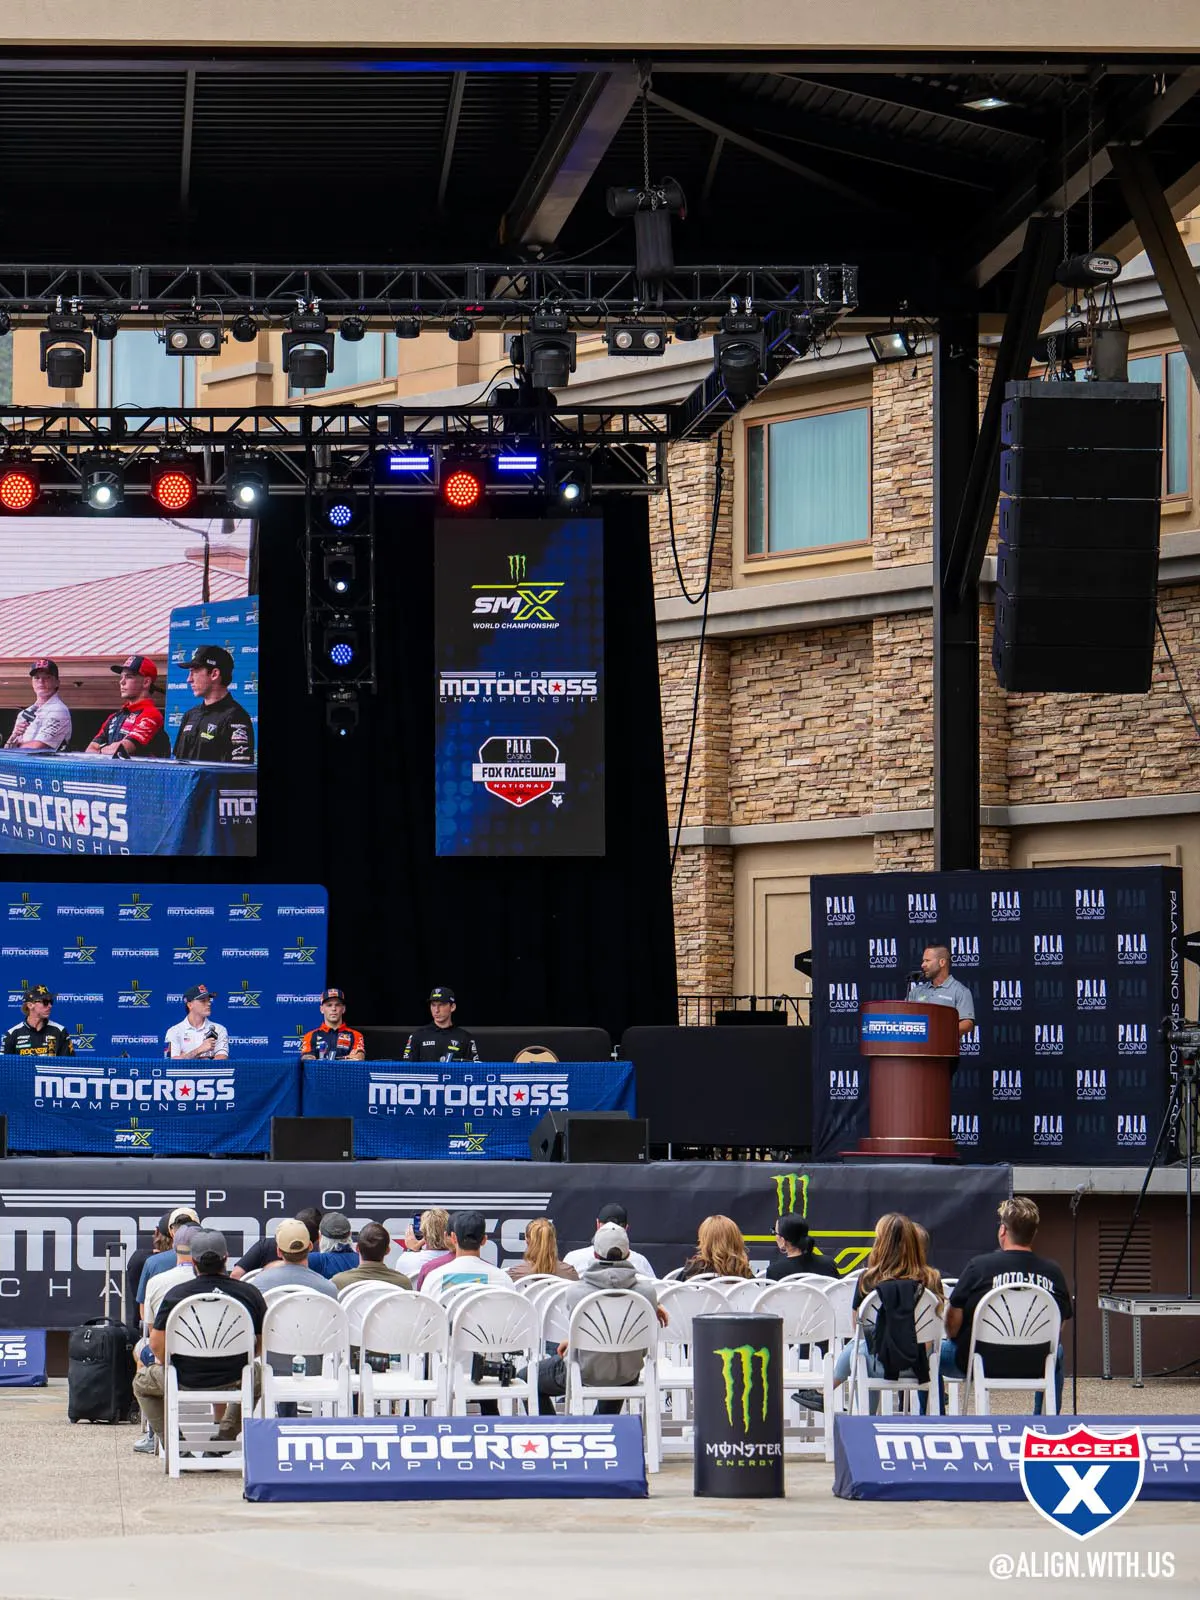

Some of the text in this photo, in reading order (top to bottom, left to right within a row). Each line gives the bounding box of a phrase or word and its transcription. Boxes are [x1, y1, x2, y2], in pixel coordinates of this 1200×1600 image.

[472, 590, 559, 620] SMX
[440, 679, 597, 696] MOTOCROSS
[506, 740, 531, 753] PALA
[482, 767, 556, 778] FOX RACEWAY
[20, 776, 60, 791] PRO
[826, 896, 855, 913] PALA
[908, 893, 936, 911] PALA
[991, 891, 1020, 909] PALA
[1075, 889, 1105, 907] PALA
[9, 906, 40, 917] SMX
[119, 907, 150, 918] SMX
[229, 906, 261, 918] SMX
[869, 938, 896, 956] PALA
[950, 936, 979, 954] PALA
[1034, 935, 1063, 953] PALA
[1117, 934, 1147, 952] PALA
[64, 950, 95, 961] SMX
[173, 950, 207, 961] SMX
[283, 950, 315, 961] SMX
[829, 983, 858, 1000] PALA
[993, 980, 1021, 998] PALA
[1077, 979, 1106, 997] PALA
[118, 994, 150, 1005] SMX
[228, 994, 260, 1005] SMX
[1077, 998, 1106, 1006] CASINO
[869, 1024, 926, 1032] MOTOCROSS
[1035, 1025, 1064, 1042] PALA
[1118, 1024, 1146, 1042] PALA
[1035, 1043, 1064, 1051] CASINO
[108, 1068, 161, 1077] PRO
[443, 1074, 496, 1082] PRO
[830, 1070, 859, 1088] PALA
[992, 1070, 1021, 1087] PALA
[1076, 1070, 1106, 1087] PALA
[35, 1076, 235, 1100] MOTOCROSS
[369, 1083, 569, 1106] MOTOCROSS
[992, 1088, 1021, 1096] CASINO
[1077, 1088, 1106, 1096] CASINO
[35, 1099, 235, 1111] CHAMPIONSHIP
[951, 1115, 978, 1133] PALA
[1034, 1115, 1063, 1133] PALA
[1117, 1115, 1146, 1133] PALA
[115, 1132, 151, 1146] SMX
[449, 1138, 485, 1151] SMX
[1117, 1133, 1146, 1141] CASINO
[206, 1190, 345, 1209] PRO
[992, 1272, 1055, 1293] MOTO-X FOX
[403, 1424, 488, 1434] PRO
[277, 1435, 617, 1460] MOTOCROSS
[706, 1441, 782, 1457] MONSTER
[278, 1460, 618, 1471] CHAMPIONSHIP
